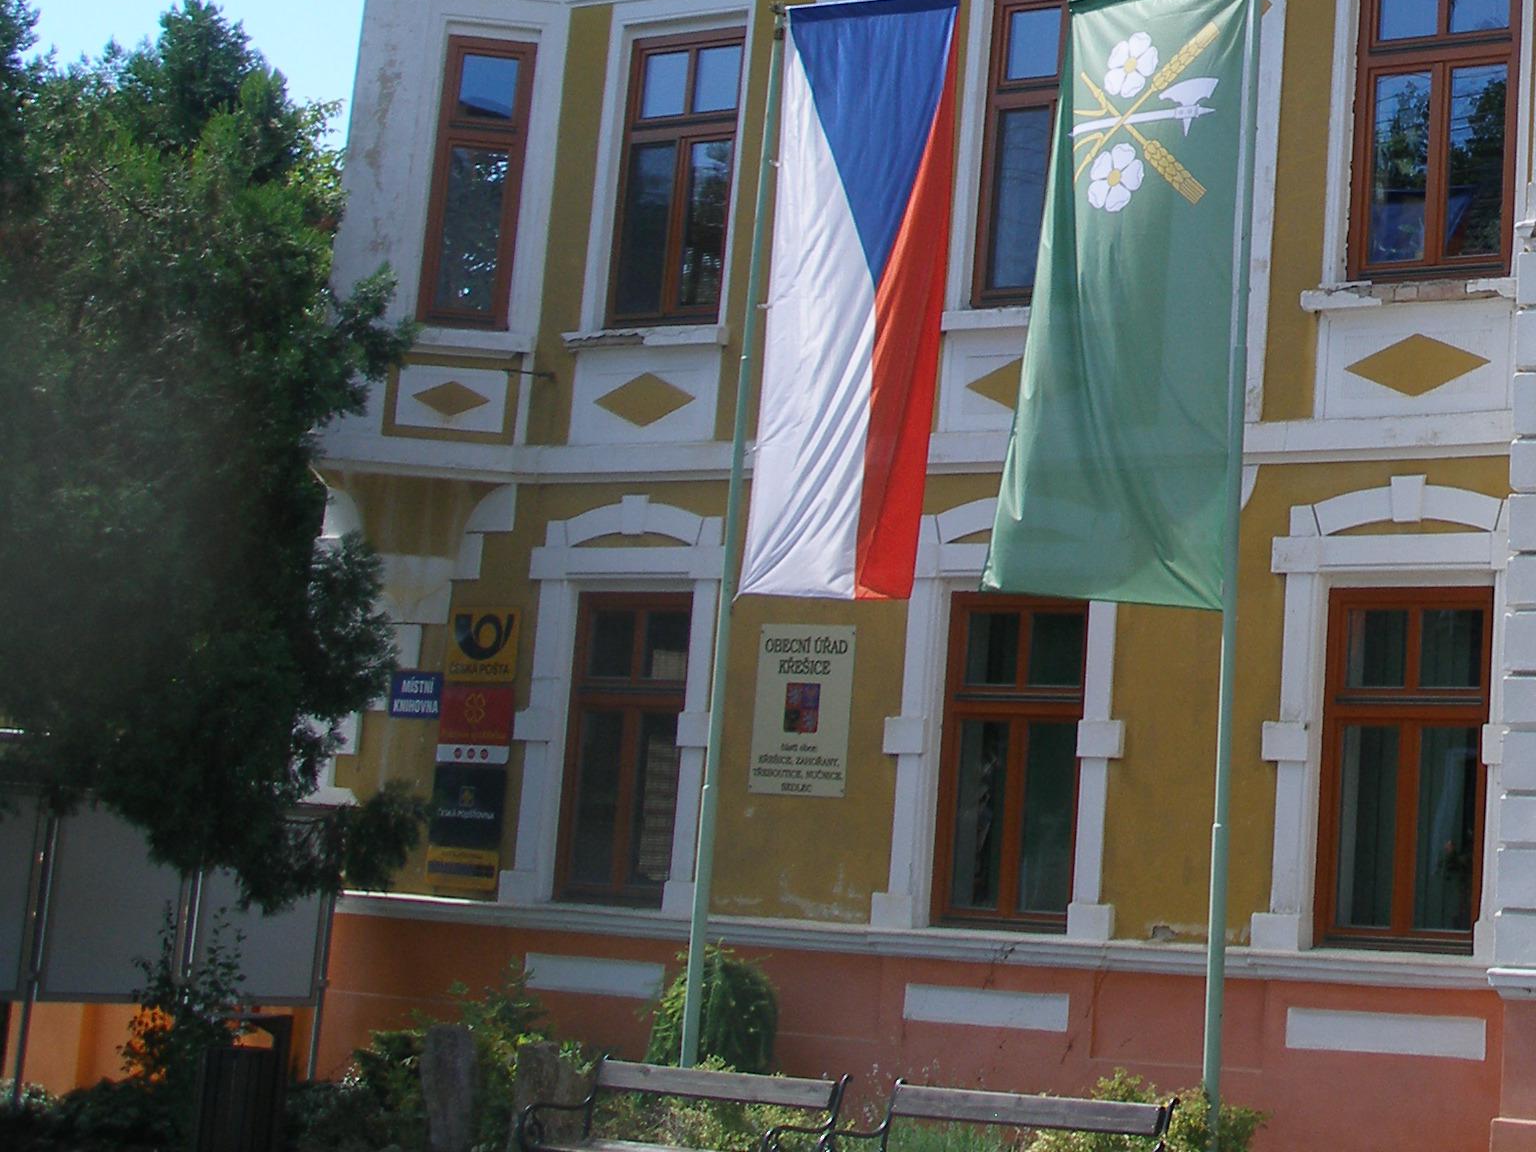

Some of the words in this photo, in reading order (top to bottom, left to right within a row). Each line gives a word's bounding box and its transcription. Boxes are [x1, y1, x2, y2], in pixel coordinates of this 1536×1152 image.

[765, 636, 812, 654] OBECNÍ
[814, 636, 848, 655] ÚŘAD
[479, 662, 509, 676] POŠTA
[778, 657, 831, 675] KŘEŠICE
[401, 676, 435, 693] MÍSTNÍ
[392, 699, 439, 714] KNIHOVNA
